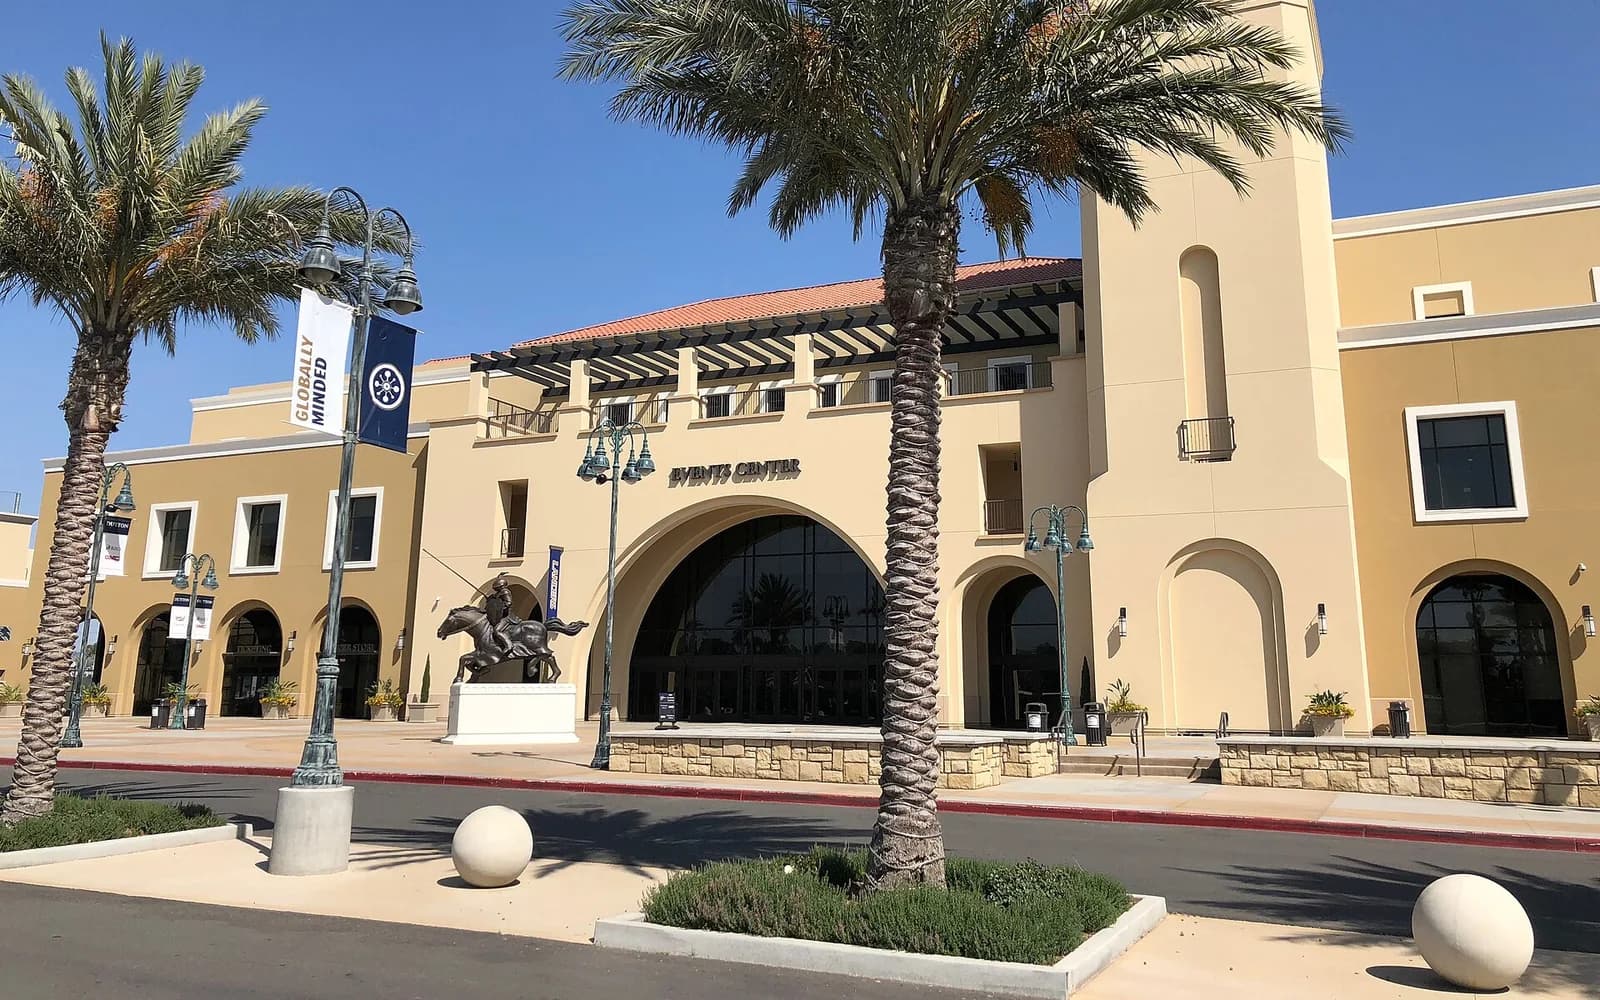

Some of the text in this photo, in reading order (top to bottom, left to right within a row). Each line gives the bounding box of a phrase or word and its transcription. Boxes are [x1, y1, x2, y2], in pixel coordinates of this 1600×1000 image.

[296, 335, 313, 421] GLOBALLY
[311, 357, 327, 426] MINDED
[669, 458, 801, 484] EVENTS CENTER
[105, 520, 129, 529] DUTTON
